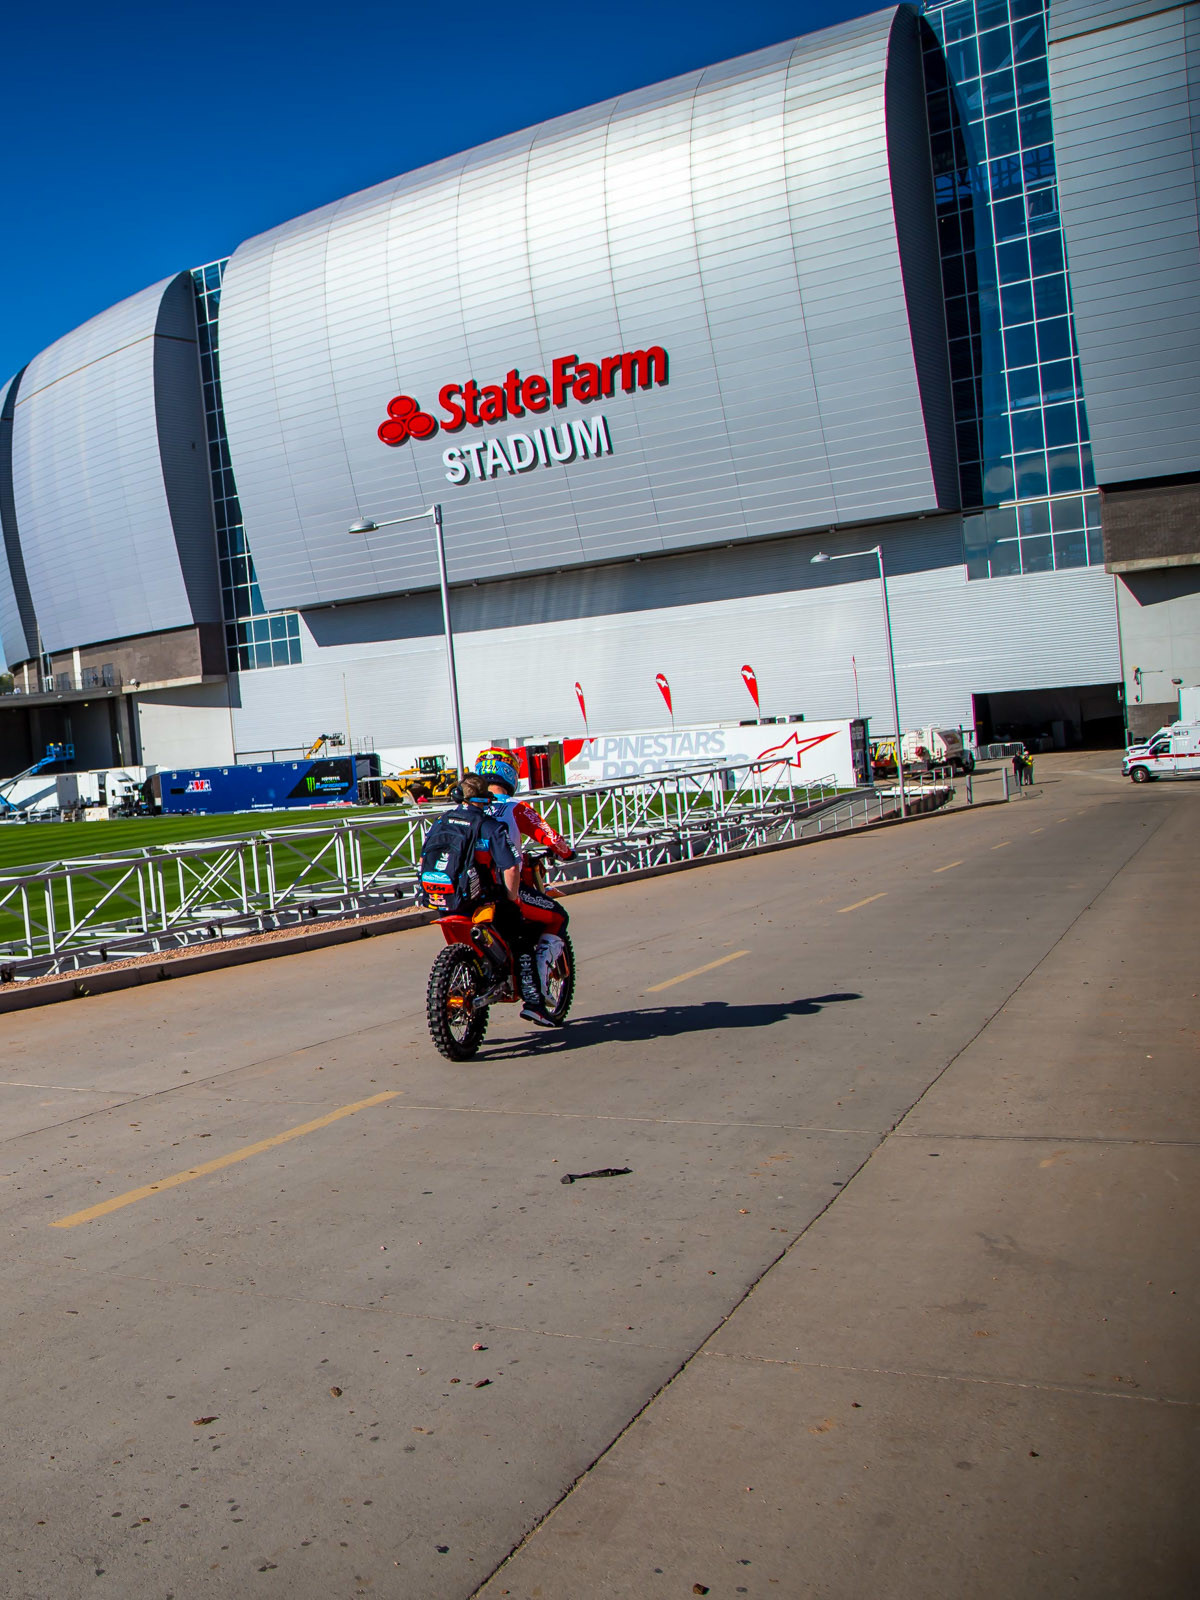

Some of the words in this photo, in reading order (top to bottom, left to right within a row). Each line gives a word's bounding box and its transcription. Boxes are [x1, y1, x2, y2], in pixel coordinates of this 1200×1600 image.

[442, 415, 612, 484] STADIUM
[578, 730, 726, 762] ALPINESTARS
[185, 780, 211, 792] AMA
